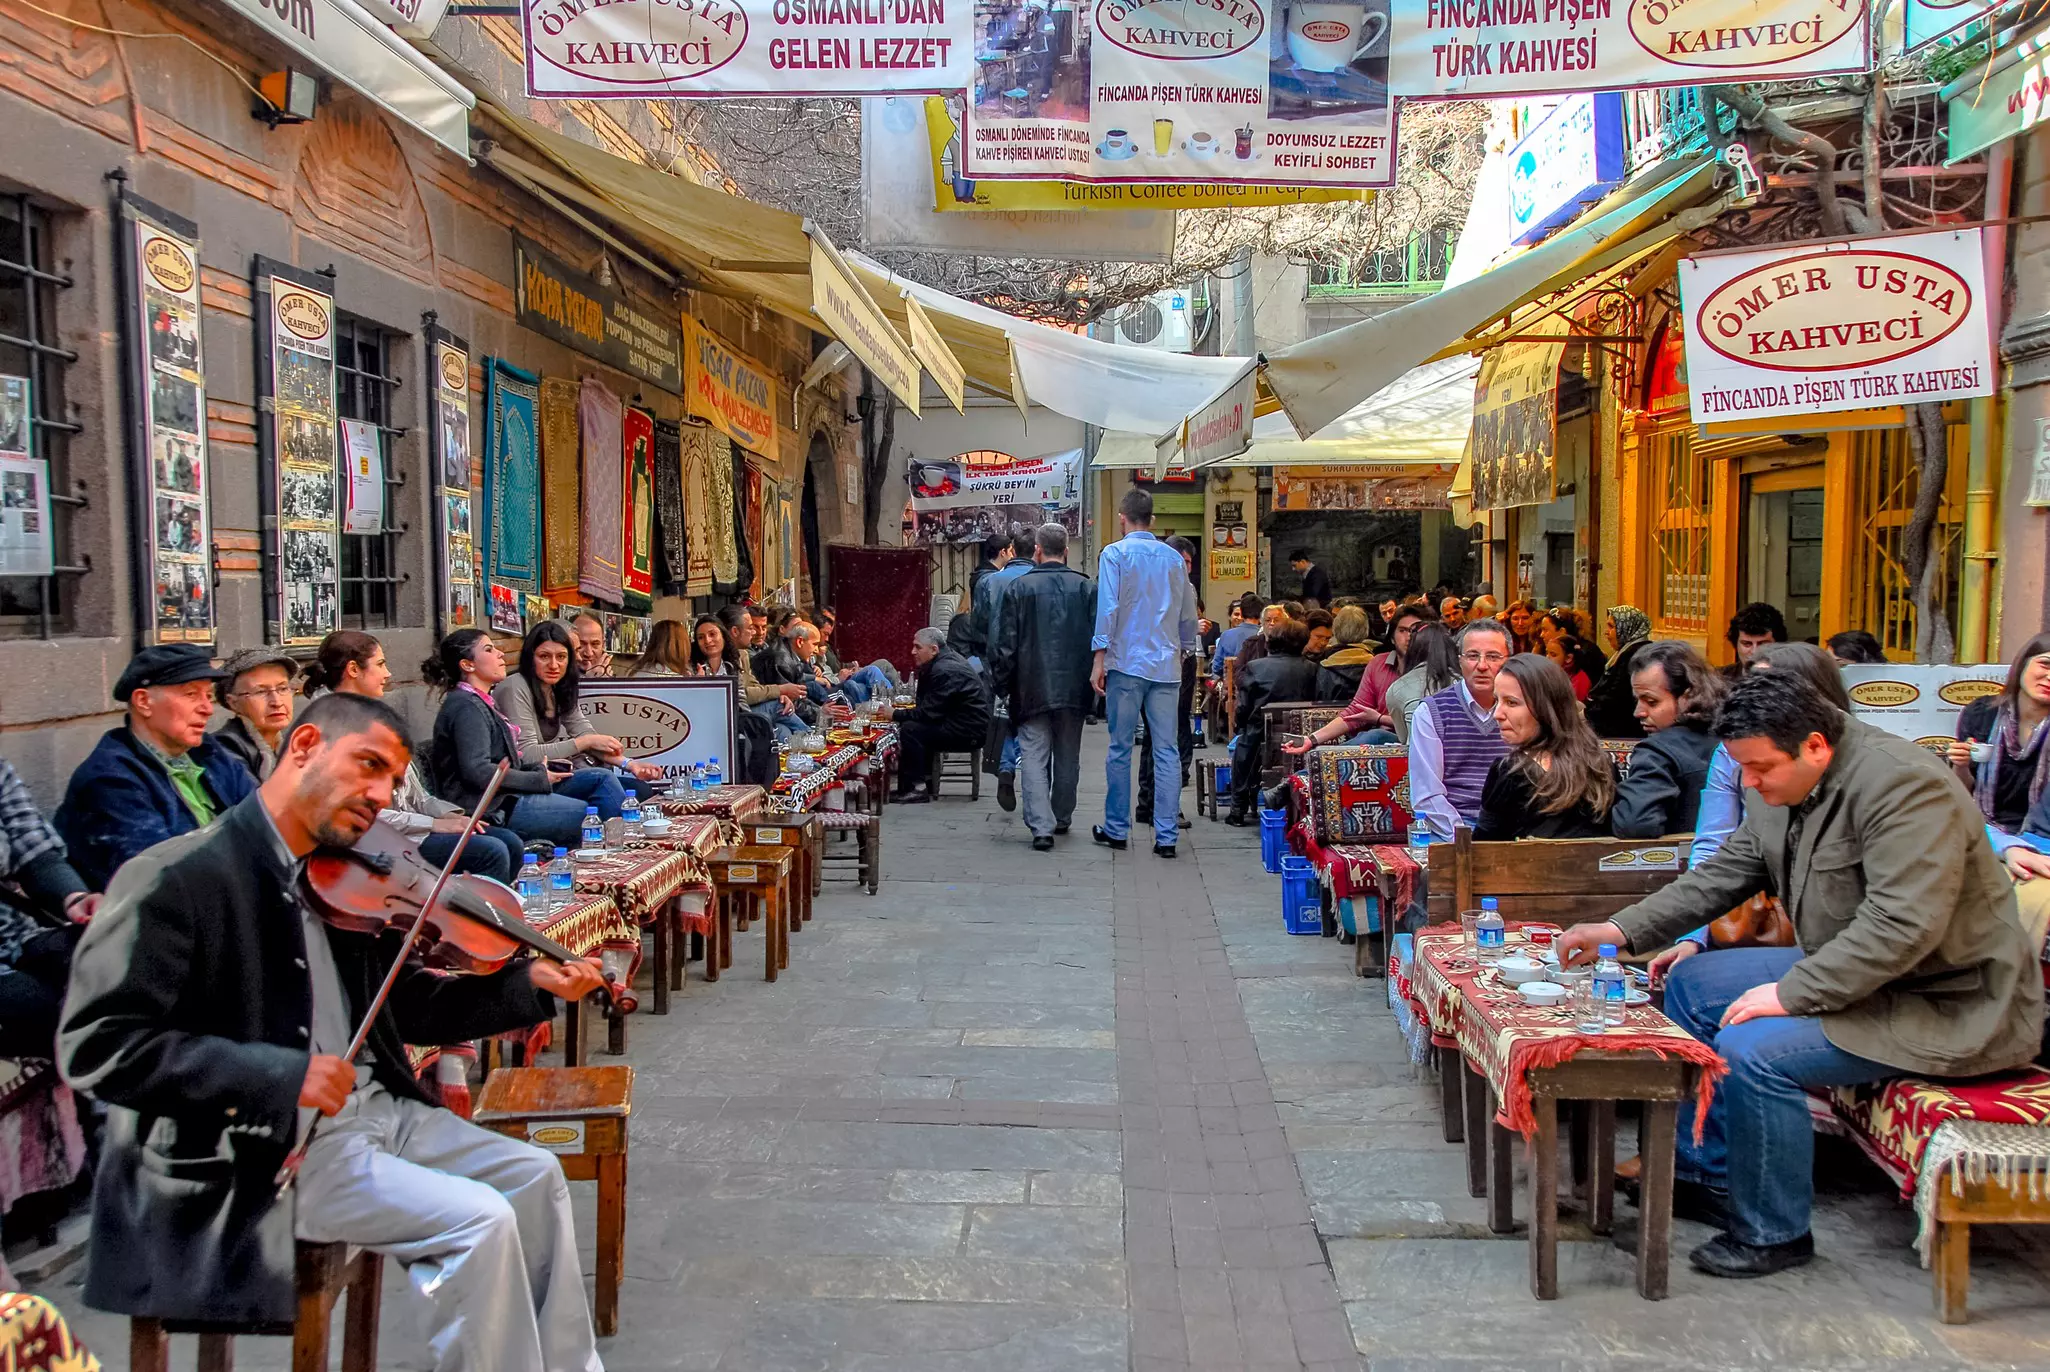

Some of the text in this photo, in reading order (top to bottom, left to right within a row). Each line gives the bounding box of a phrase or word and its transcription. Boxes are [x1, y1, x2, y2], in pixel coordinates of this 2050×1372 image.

[538, 0, 641, 36] ÖM
[1124, 28, 1236, 49] KAHVECİ
[1666, 13, 1825, 55] KAHVECİ
[565, 36, 713, 65] KAHVECİ
[769, 37, 952, 70] GELEN LEZZET
[1432, 28, 1597, 77] TÜRK KAHVESİ
[1098, 82, 1263, 105] FİNCANDA PİŞEN TÜRK KAHVESİ
[975, 126, 1091, 145] OSMANLI DÖNEMİNDE FİNCANDA
[1266, 131, 1387, 150] DOYUMSUZ LEZZET
[975, 144, 1090, 164] KAHVE PİŞİREN KAHVECİ USTASI
[1273, 151, 1376, 170] KEYİFLİ SOHBET
[306, 299, 327, 329] USTA
[1712, 265, 1956, 338] ÖMER USTA
[605, 316, 633, 345] TOPTAN
[1748, 308, 1924, 355] KAHVECİ
[1701, 384, 1791, 413] FİNCANDA
[1793, 375, 1846, 410] PİŞEN
[1850, 370, 1900, 400] TÜRK
[1902, 359, 1980, 393] KAHVESİ
[969, 477, 1036, 493] ŞÜKRÜ BEY'İN
[992, 491, 1015, 504] YERİ
[1856, 685, 1912, 695] ÖMER USTA
[622, 702, 682, 732] USTA
